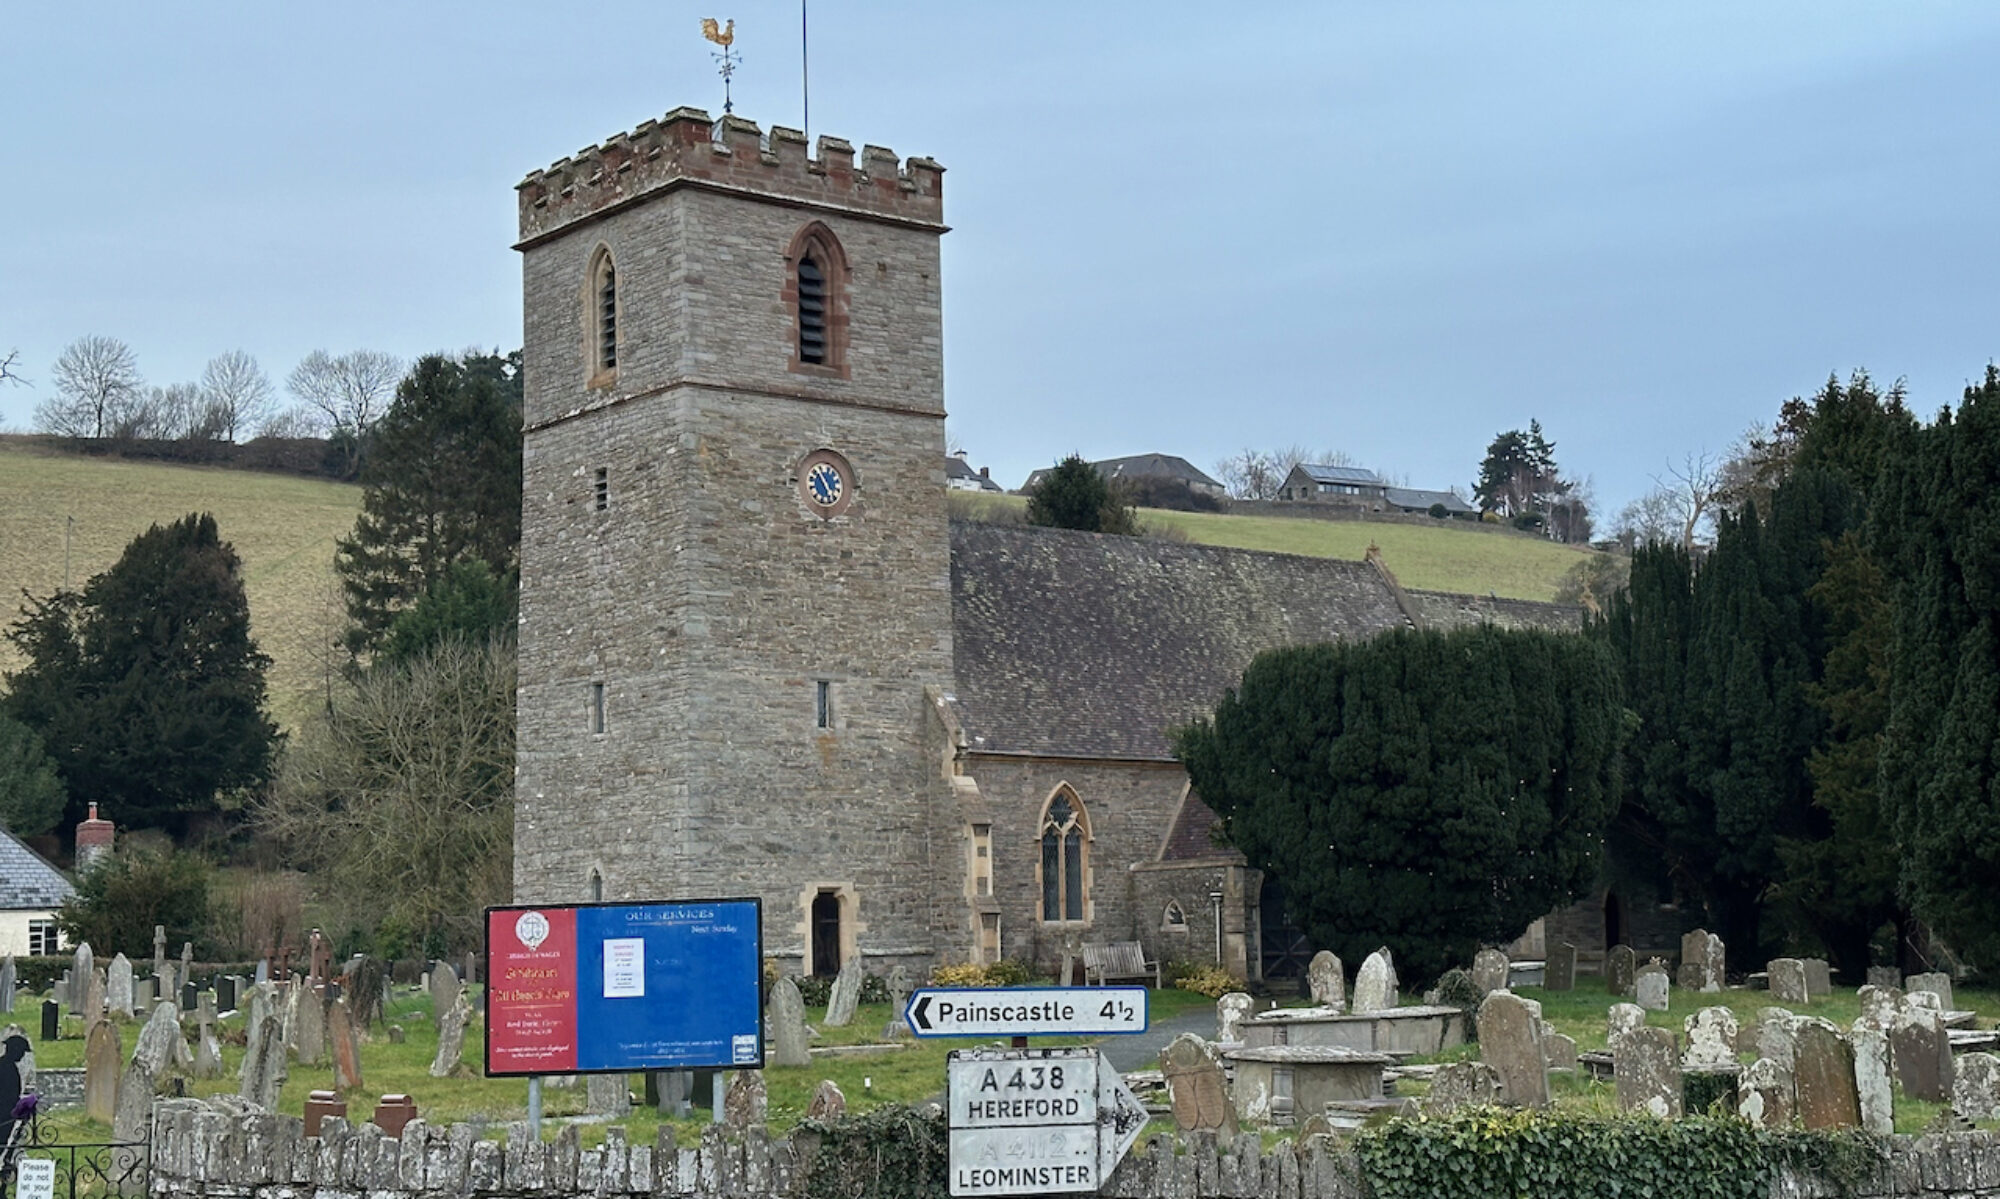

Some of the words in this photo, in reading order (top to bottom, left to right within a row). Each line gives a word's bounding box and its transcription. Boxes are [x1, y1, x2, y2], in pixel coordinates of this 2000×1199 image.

[939, 1001, 1075, 1023] Painscastle
[968, 1098, 1080, 1119] HEREFORD
[23, 1162, 49, 1171] Please
[23, 1173, 33, 1181] do
[36, 1173, 49, 1181] not
[959, 1165, 1091, 1188] LEOMINSTER
